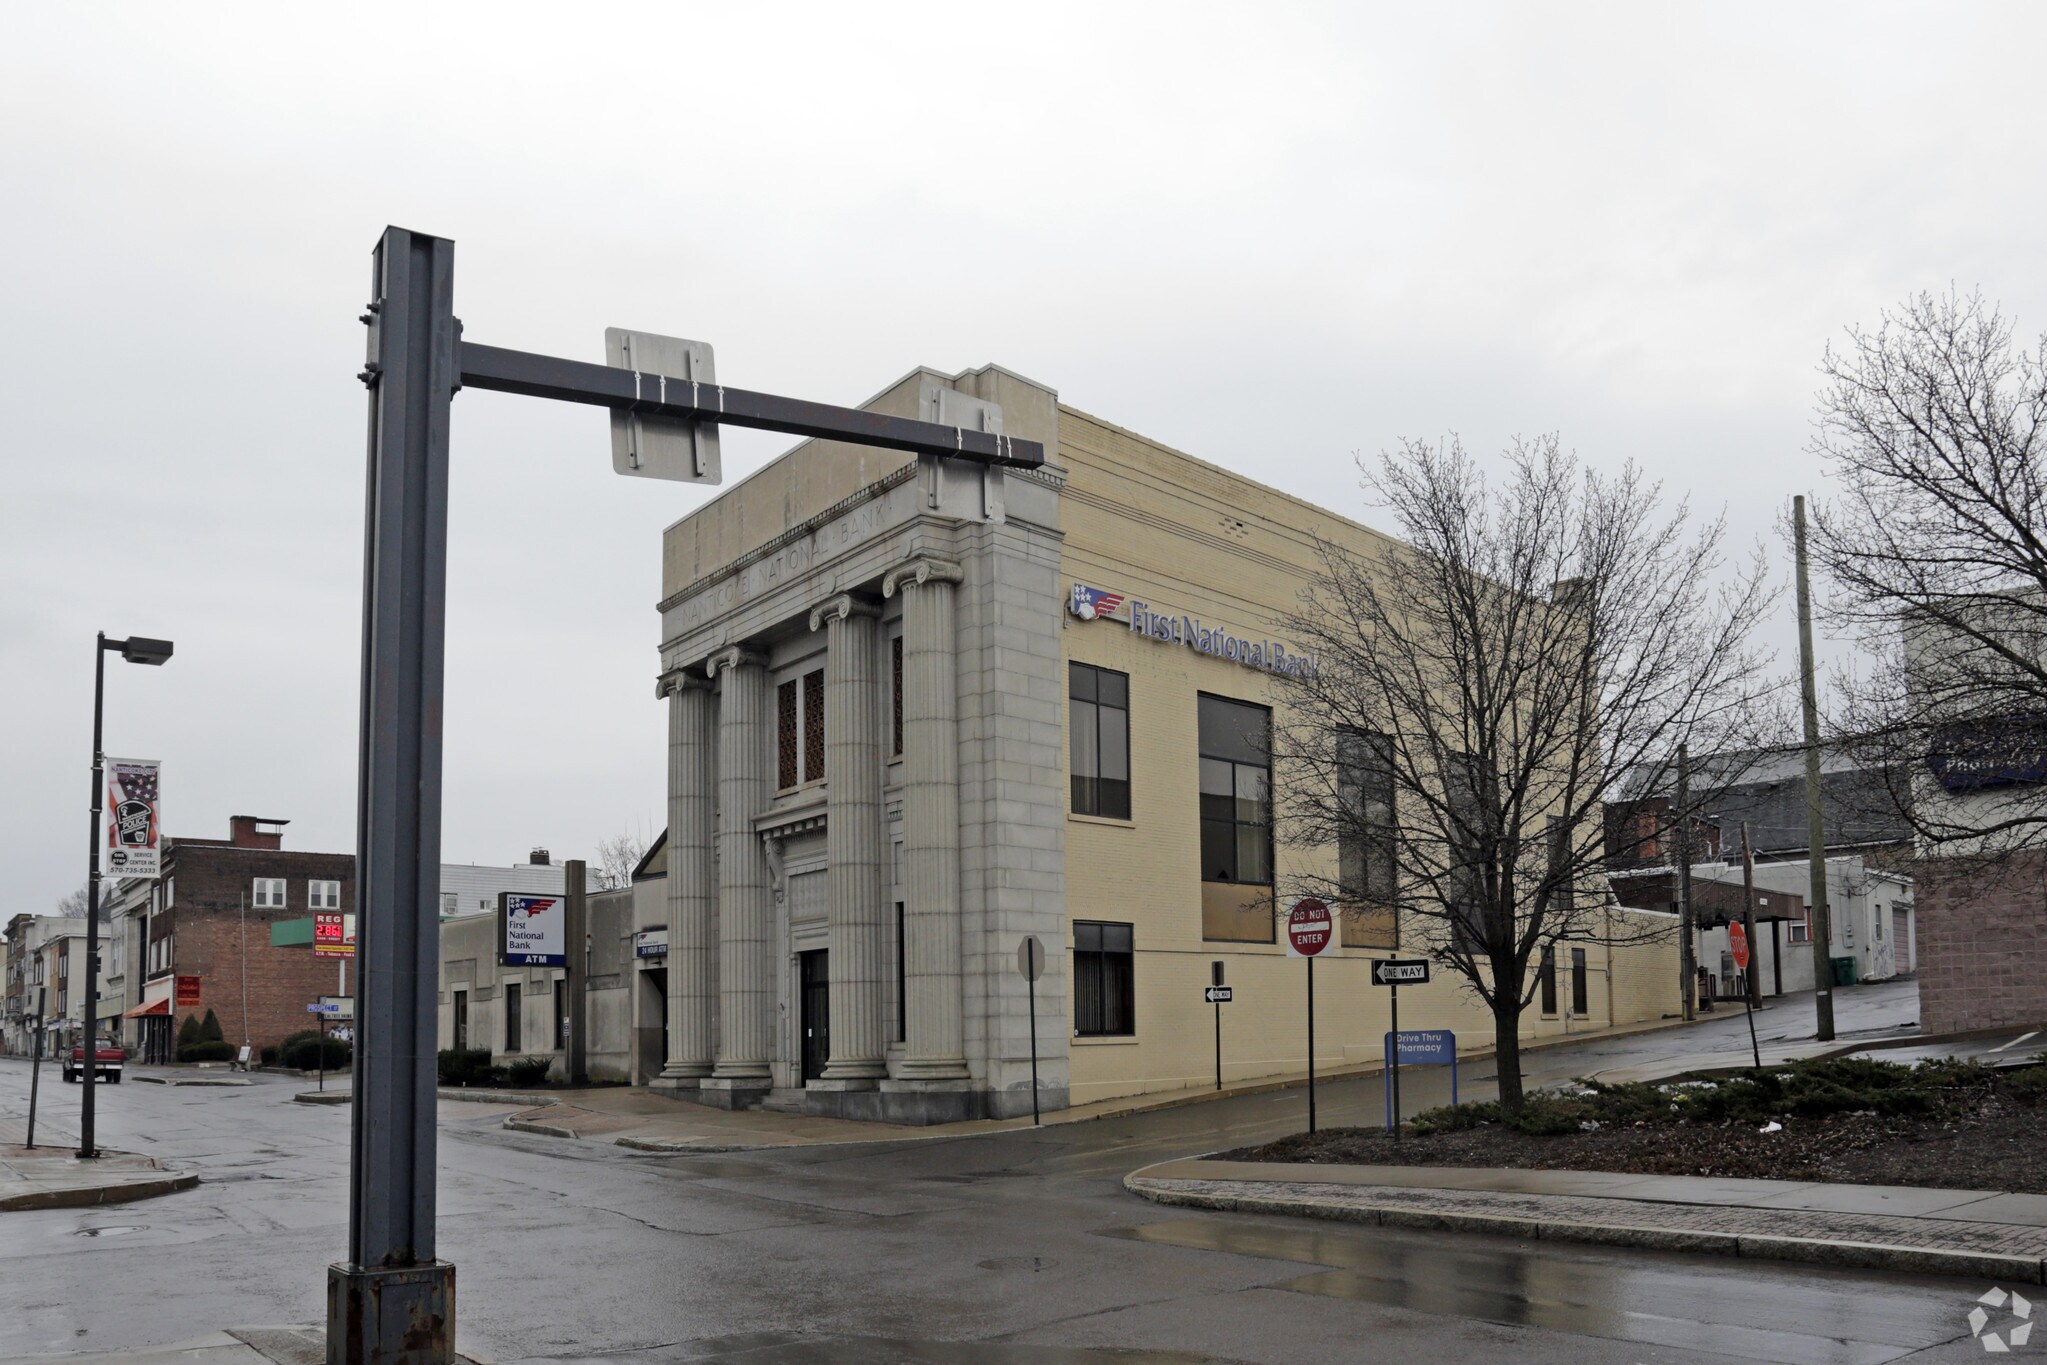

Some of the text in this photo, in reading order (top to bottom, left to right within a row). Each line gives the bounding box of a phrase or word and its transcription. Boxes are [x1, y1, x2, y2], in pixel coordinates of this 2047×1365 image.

[682, 504, 885, 625] NANTICOKE NATIONAL BANK
[1129, 600, 1178, 645] First
[1181, 615, 1268, 668] National
[122, 815, 147, 830] POLICE
[317, 915, 341, 923] REG
[1294, 909, 1325, 921] DO NOT
[509, 921, 526, 930] First
[509, 931, 544, 940] National
[1297, 933, 1323, 945] ENTER
[509, 940, 531, 950] Bank
[647, 945, 659, 954] HOUR
[1730, 936, 1747, 953] STOP
[525, 955, 547, 964] ATM
[1384, 966, 1422, 979] ONE WAY
[307, 1004, 331, 1012] PROSPECT
[1397, 1033, 1441, 1043] Drive Thru
[1397, 1043, 1442, 1053] Pharmacy
